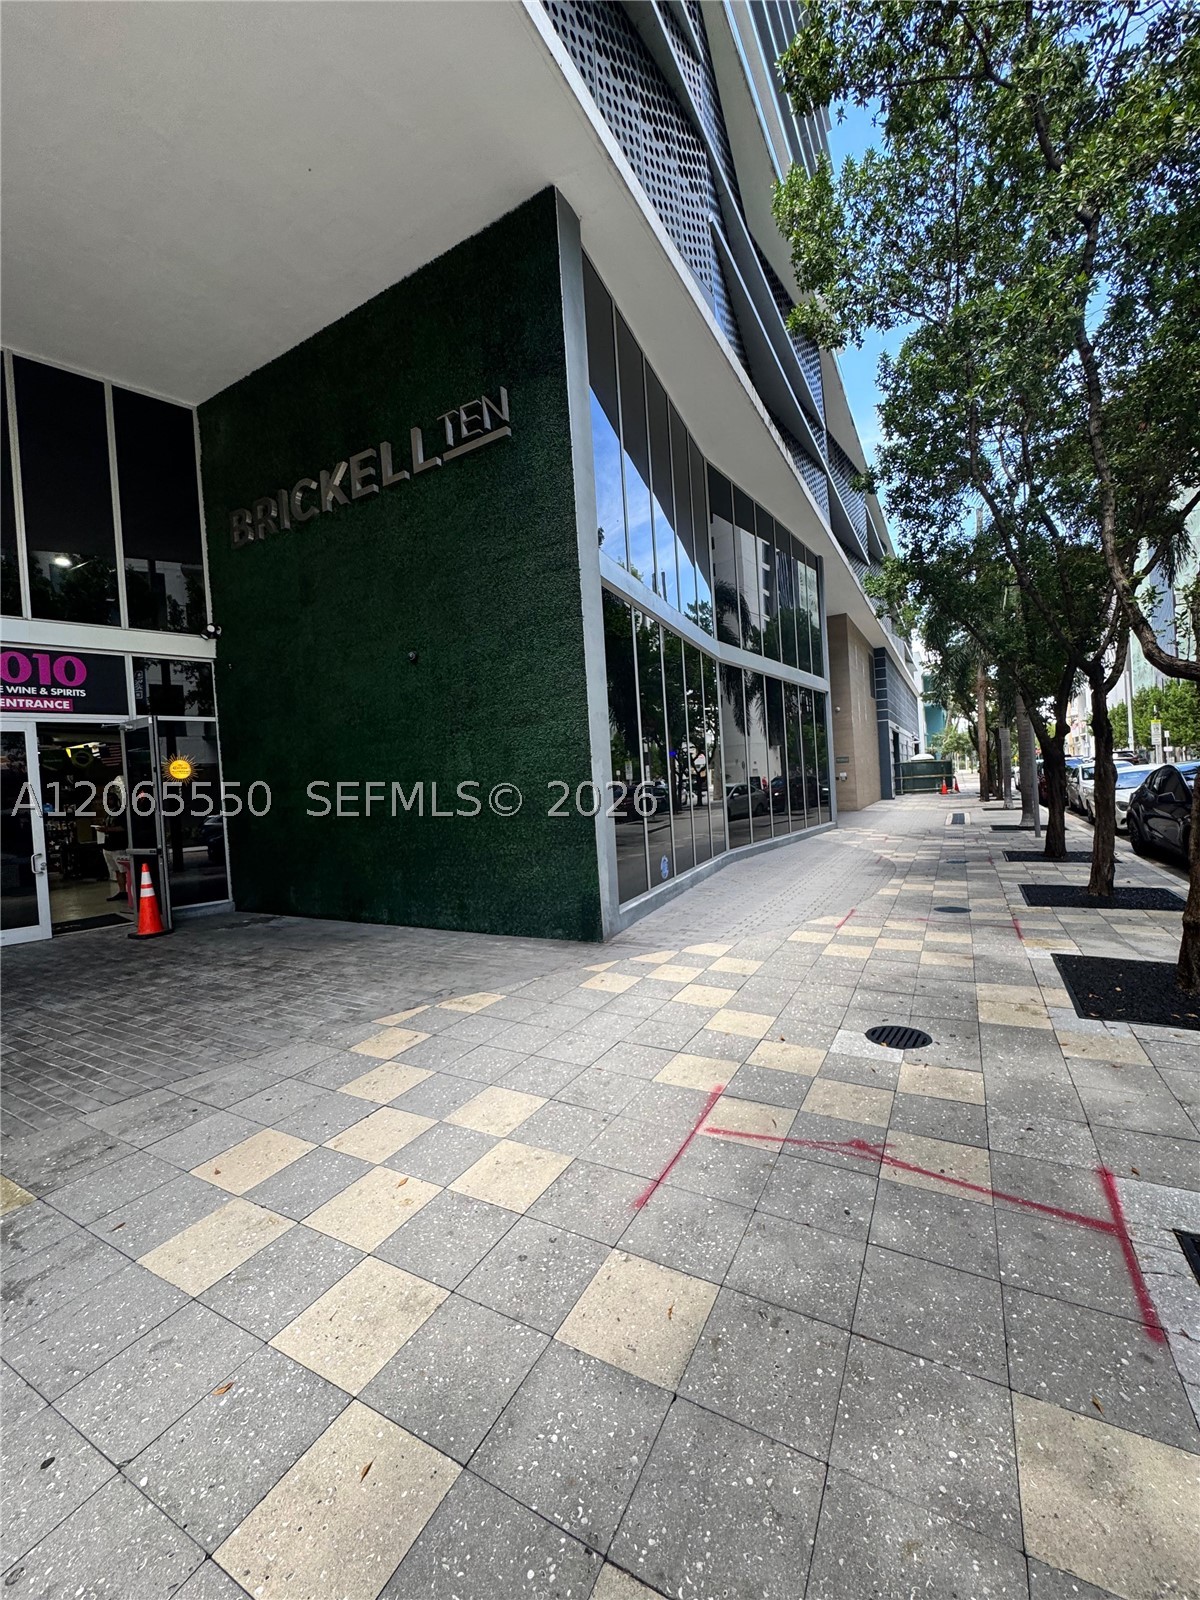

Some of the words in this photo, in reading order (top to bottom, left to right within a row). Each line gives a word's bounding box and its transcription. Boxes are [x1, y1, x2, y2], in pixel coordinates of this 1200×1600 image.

[228, 426, 442, 549] BRICKELL
[436, 386, 510, 447] TEN
[6, 685, 37, 695] WINE
[39, 687, 49, 696] &
[50, 688, 87, 697] SPIRITS
[0, 698, 71, 710] ENTRANCE
